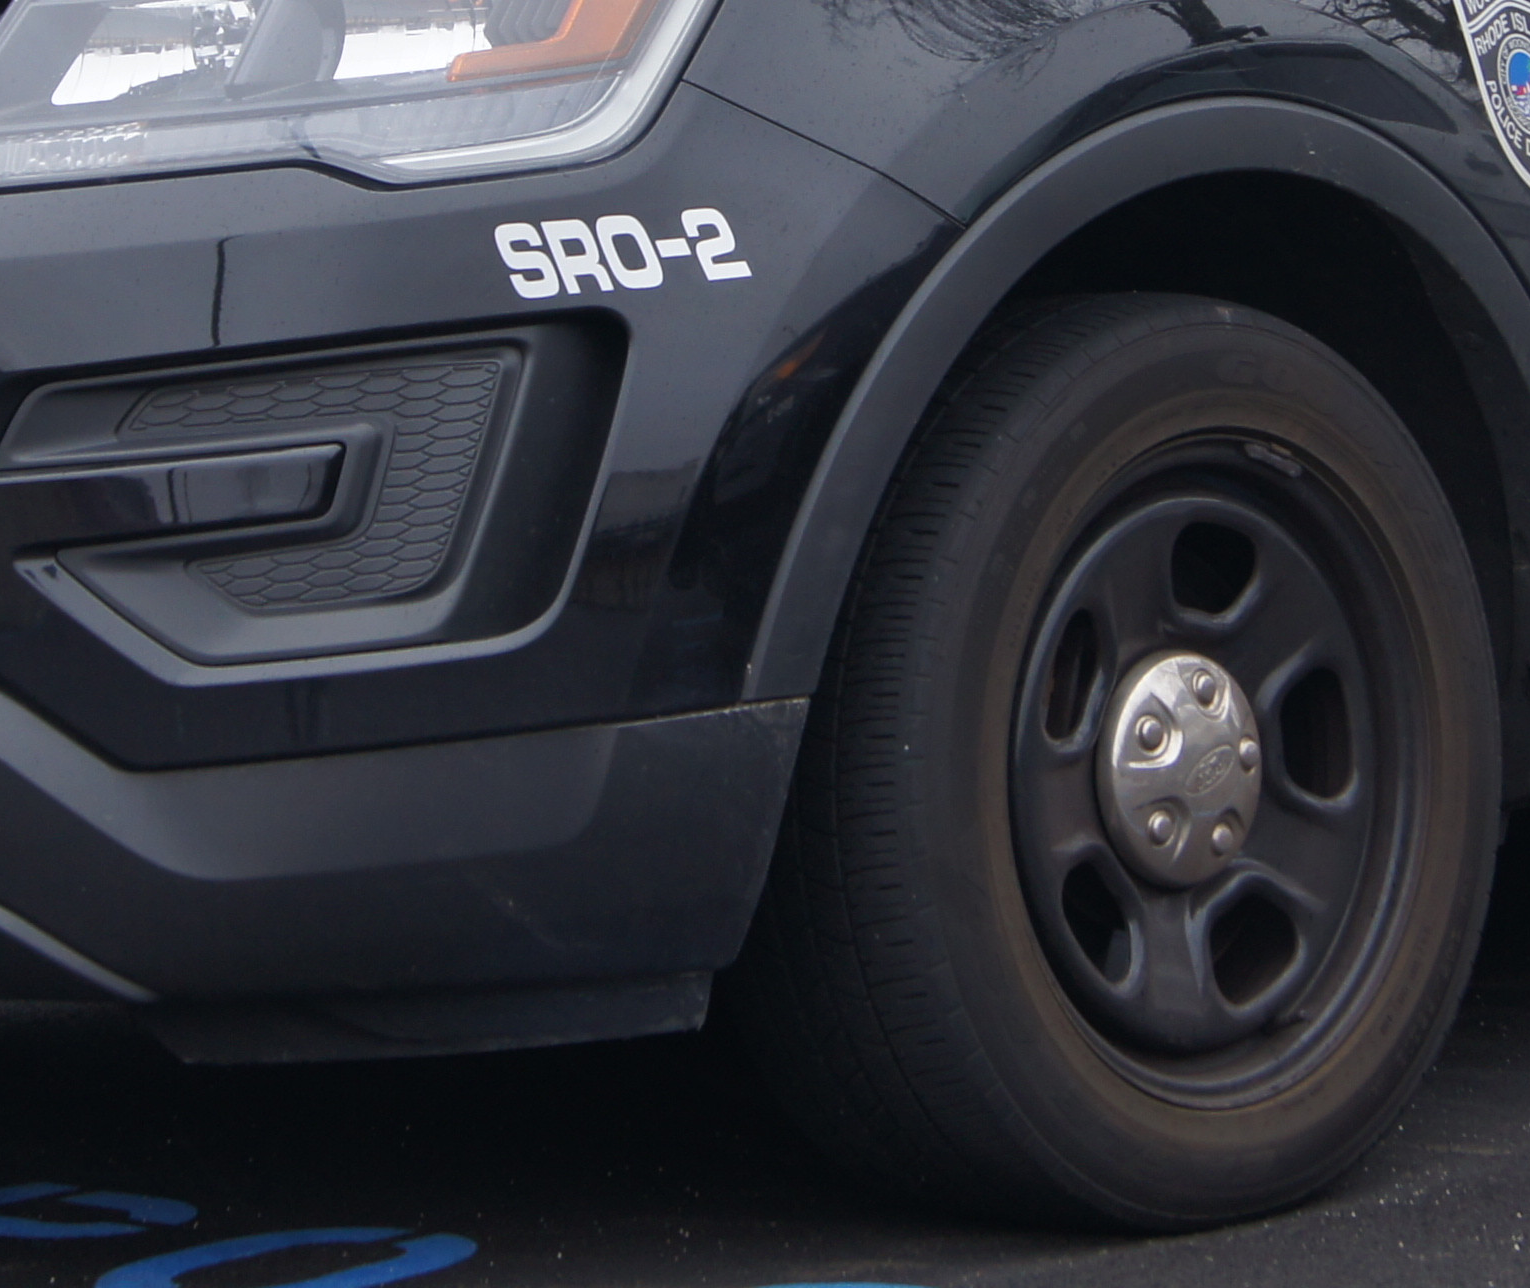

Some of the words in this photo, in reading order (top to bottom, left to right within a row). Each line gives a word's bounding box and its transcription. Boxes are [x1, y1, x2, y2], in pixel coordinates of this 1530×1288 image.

[1474, 13, 1510, 57] RHODE
[1486, 79, 1523, 150] POLICE
[494, 207, 752, 299] SRO-2
